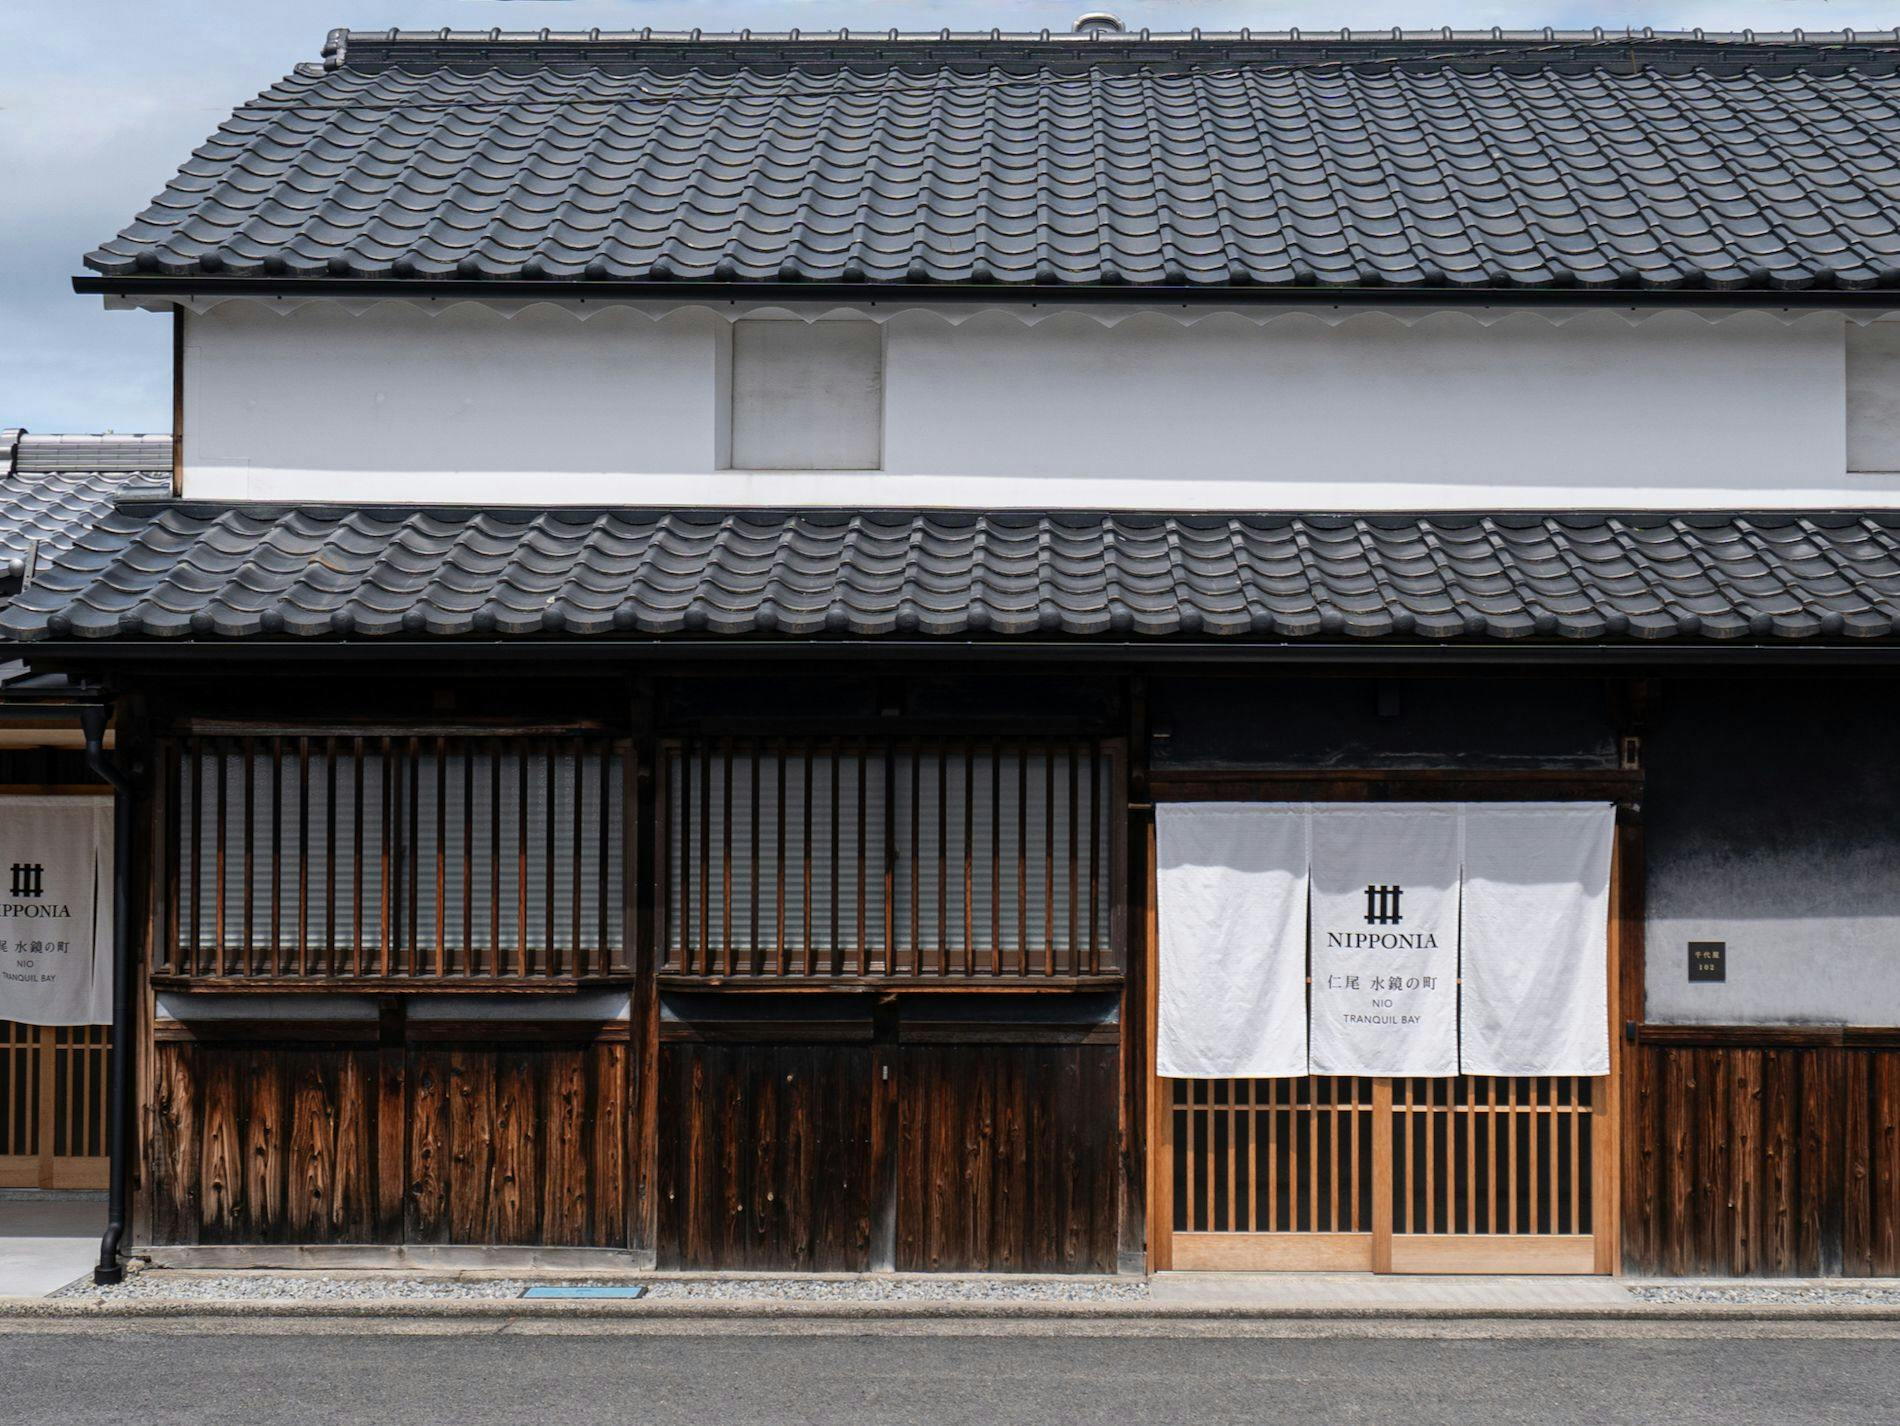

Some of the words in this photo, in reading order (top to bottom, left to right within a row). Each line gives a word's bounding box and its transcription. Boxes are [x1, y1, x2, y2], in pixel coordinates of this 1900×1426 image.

[0, 903, 72, 918] PPONIA
[1327, 932, 1438, 949] NIPPONIA
[16, 960, 34, 968] NIO
[41, 974, 56, 983] BAY
[1328, 974, 1360, 990] 仁尾
[1370, 976, 1437, 991] 水鏡の町
[1372, 999, 1393, 1008] NIO
[1344, 1014, 1397, 1025] TRANQUIL
[1401, 1015, 1421, 1024] BAY
